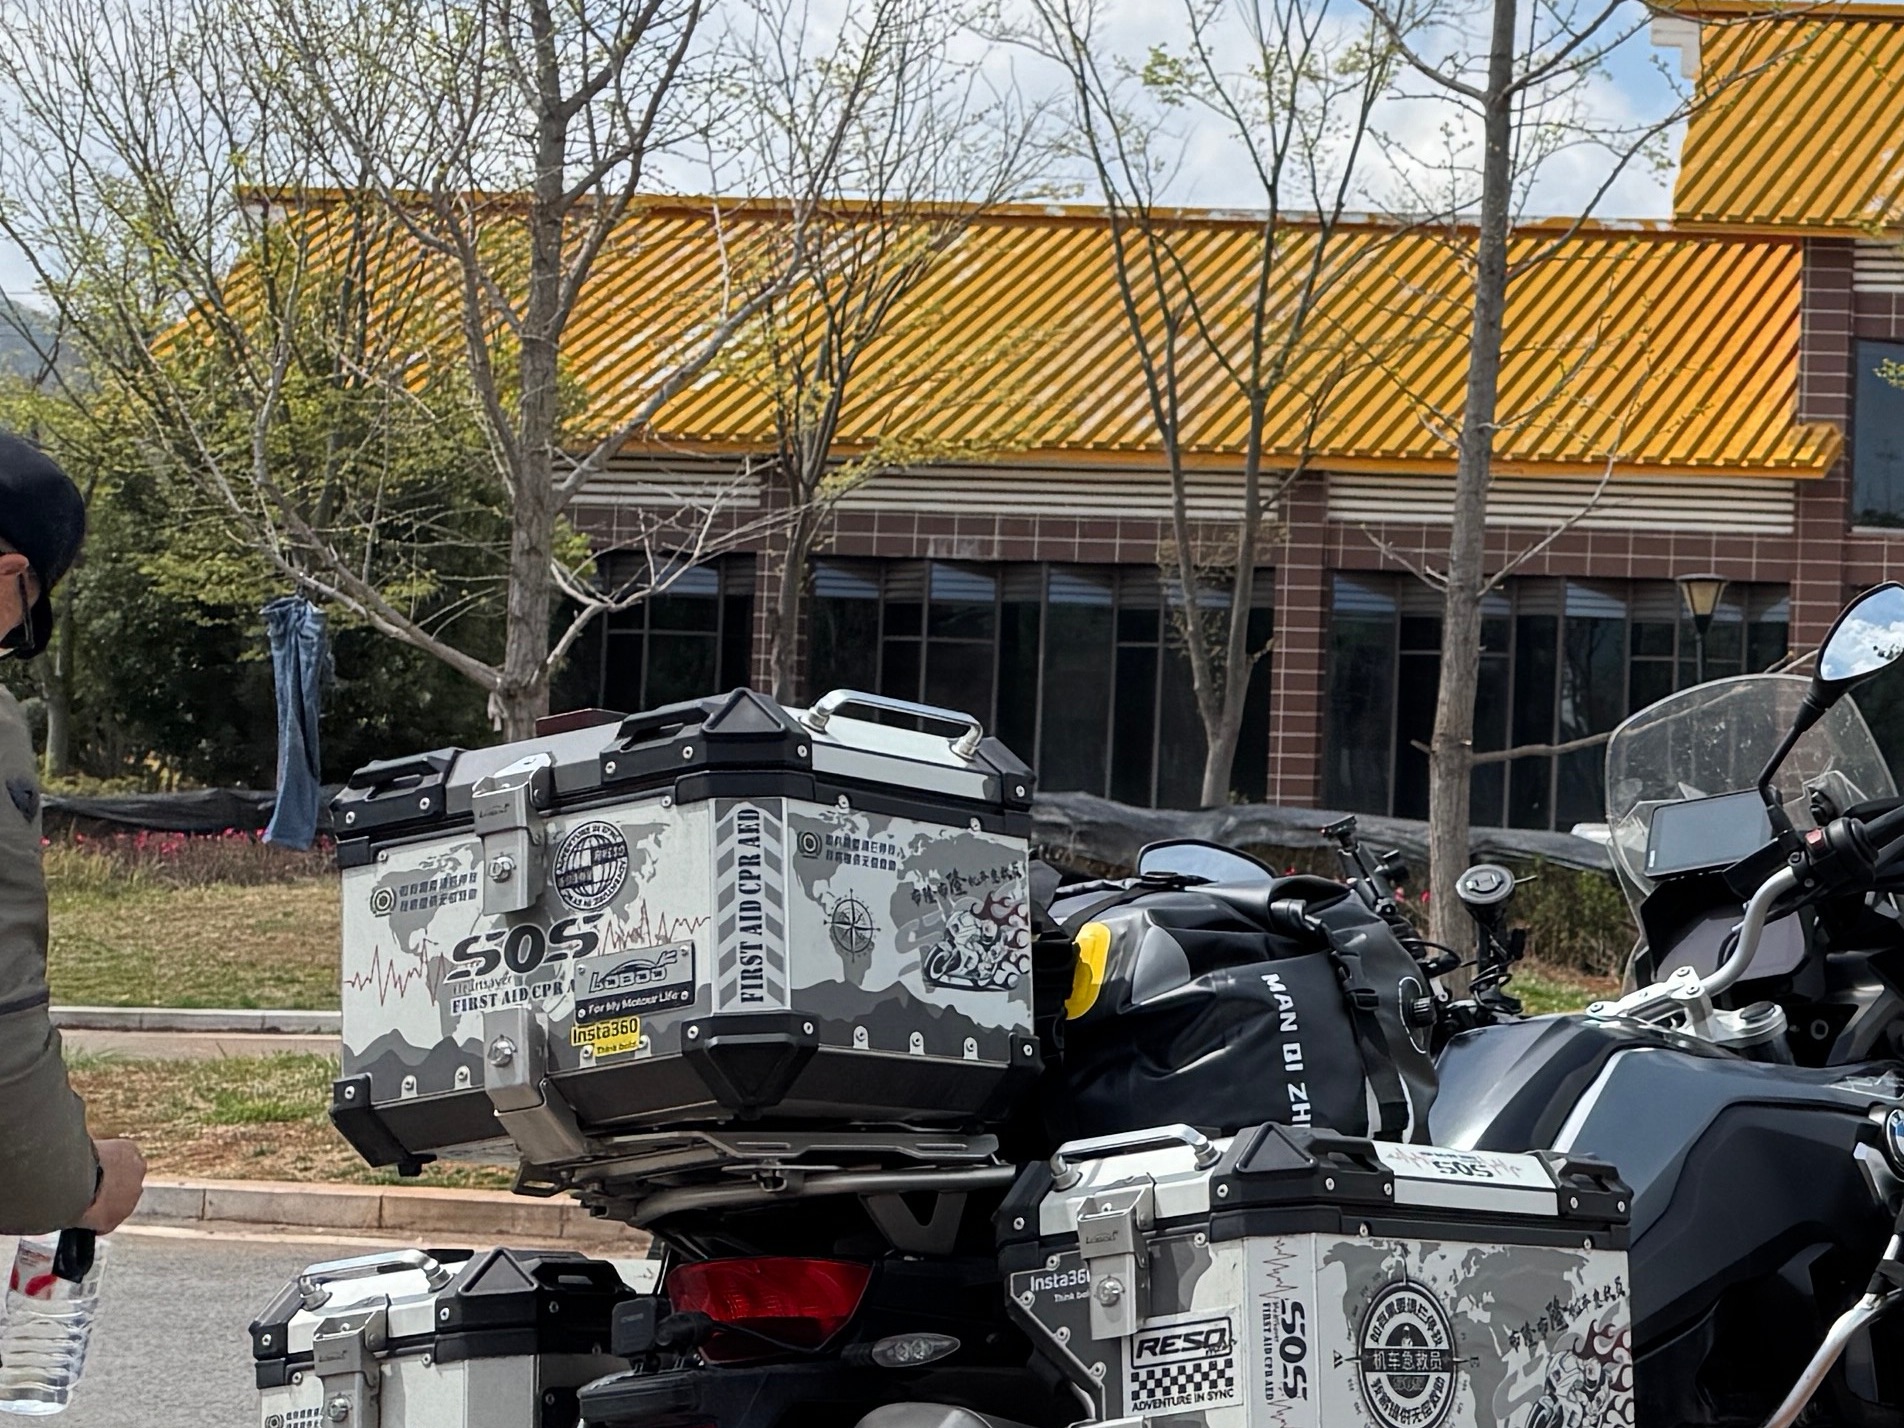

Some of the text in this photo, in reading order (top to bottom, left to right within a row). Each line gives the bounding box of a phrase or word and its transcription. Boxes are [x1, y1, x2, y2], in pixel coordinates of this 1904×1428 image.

[737, 809, 764, 1003] FIRST AID CPR AED
[446, 913, 604, 980] SOS
[453, 993, 498, 1014] FIRST
[502, 987, 529, 1006] AID
[533, 981, 563, 999] CPR
[573, 1018, 638, 1044] Insta360
[1261, 973, 1298, 1032] MAN
[1283, 1043, 1304, 1071] QI
[1432, 1160, 1494, 1178] SOS
[1031, 1269, 1090, 1292] Insta36
[1263, 1336, 1272, 1354] AID
[1279, 1299, 1308, 1401] SOS
[1373, 1350, 1443, 1371] 机车急救员
[1132, 1389, 1234, 1412] ADVENTURE IN SYNC
[1265, 1380, 1274, 1401] AED
